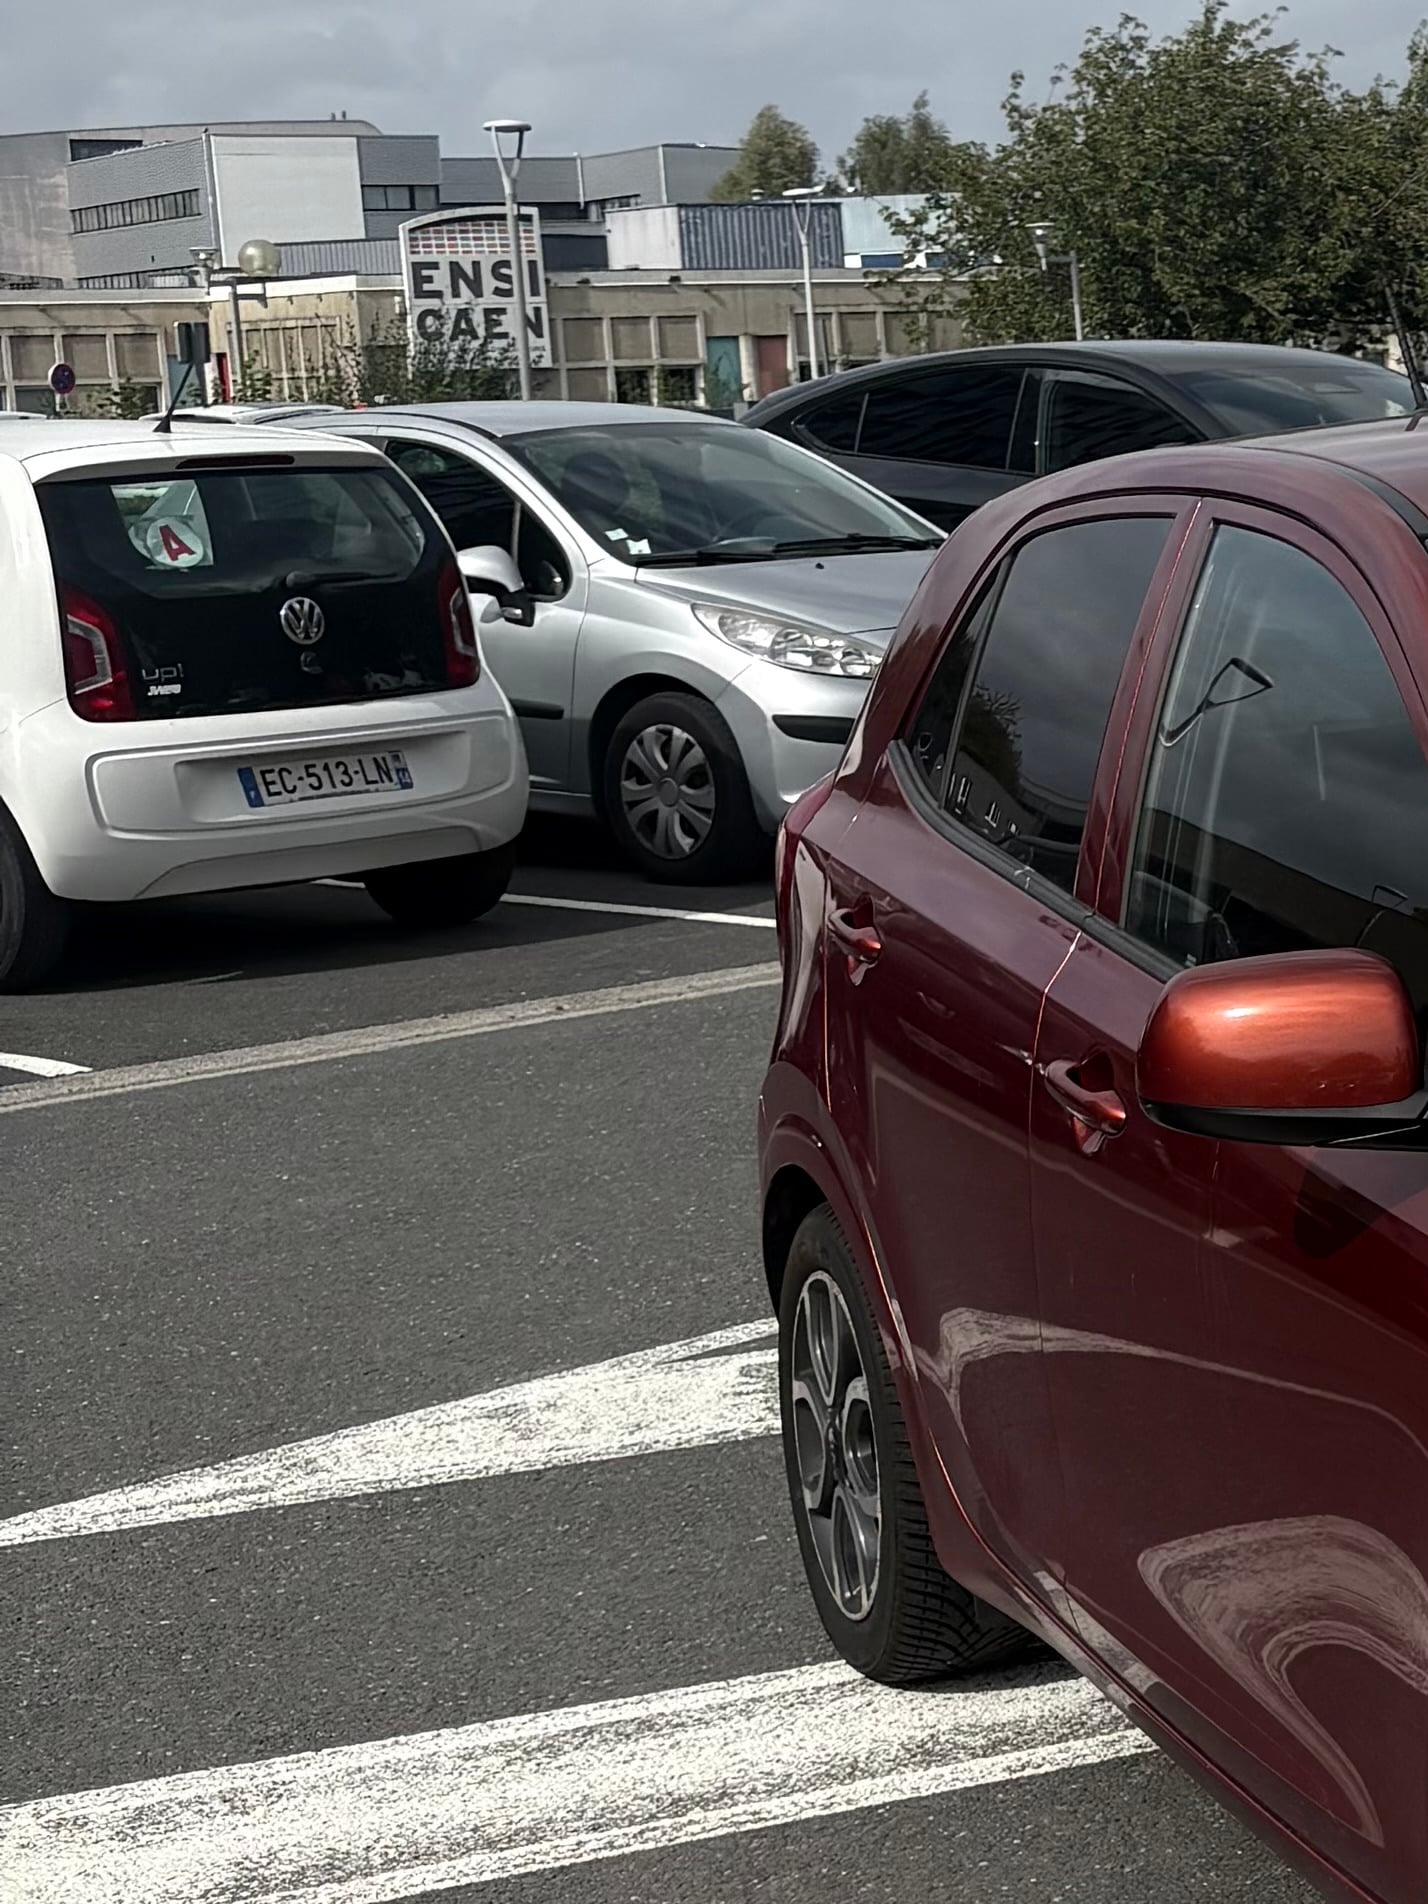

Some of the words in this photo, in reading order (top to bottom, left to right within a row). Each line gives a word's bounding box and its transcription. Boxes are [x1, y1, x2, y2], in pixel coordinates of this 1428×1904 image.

[411, 259, 541, 299] ENSI
[416, 306, 544, 342] CAEN
[159, 524, 196, 562] A
[142, 663, 185, 682] up!
[259, 756, 394, 797] EC-513-LN
